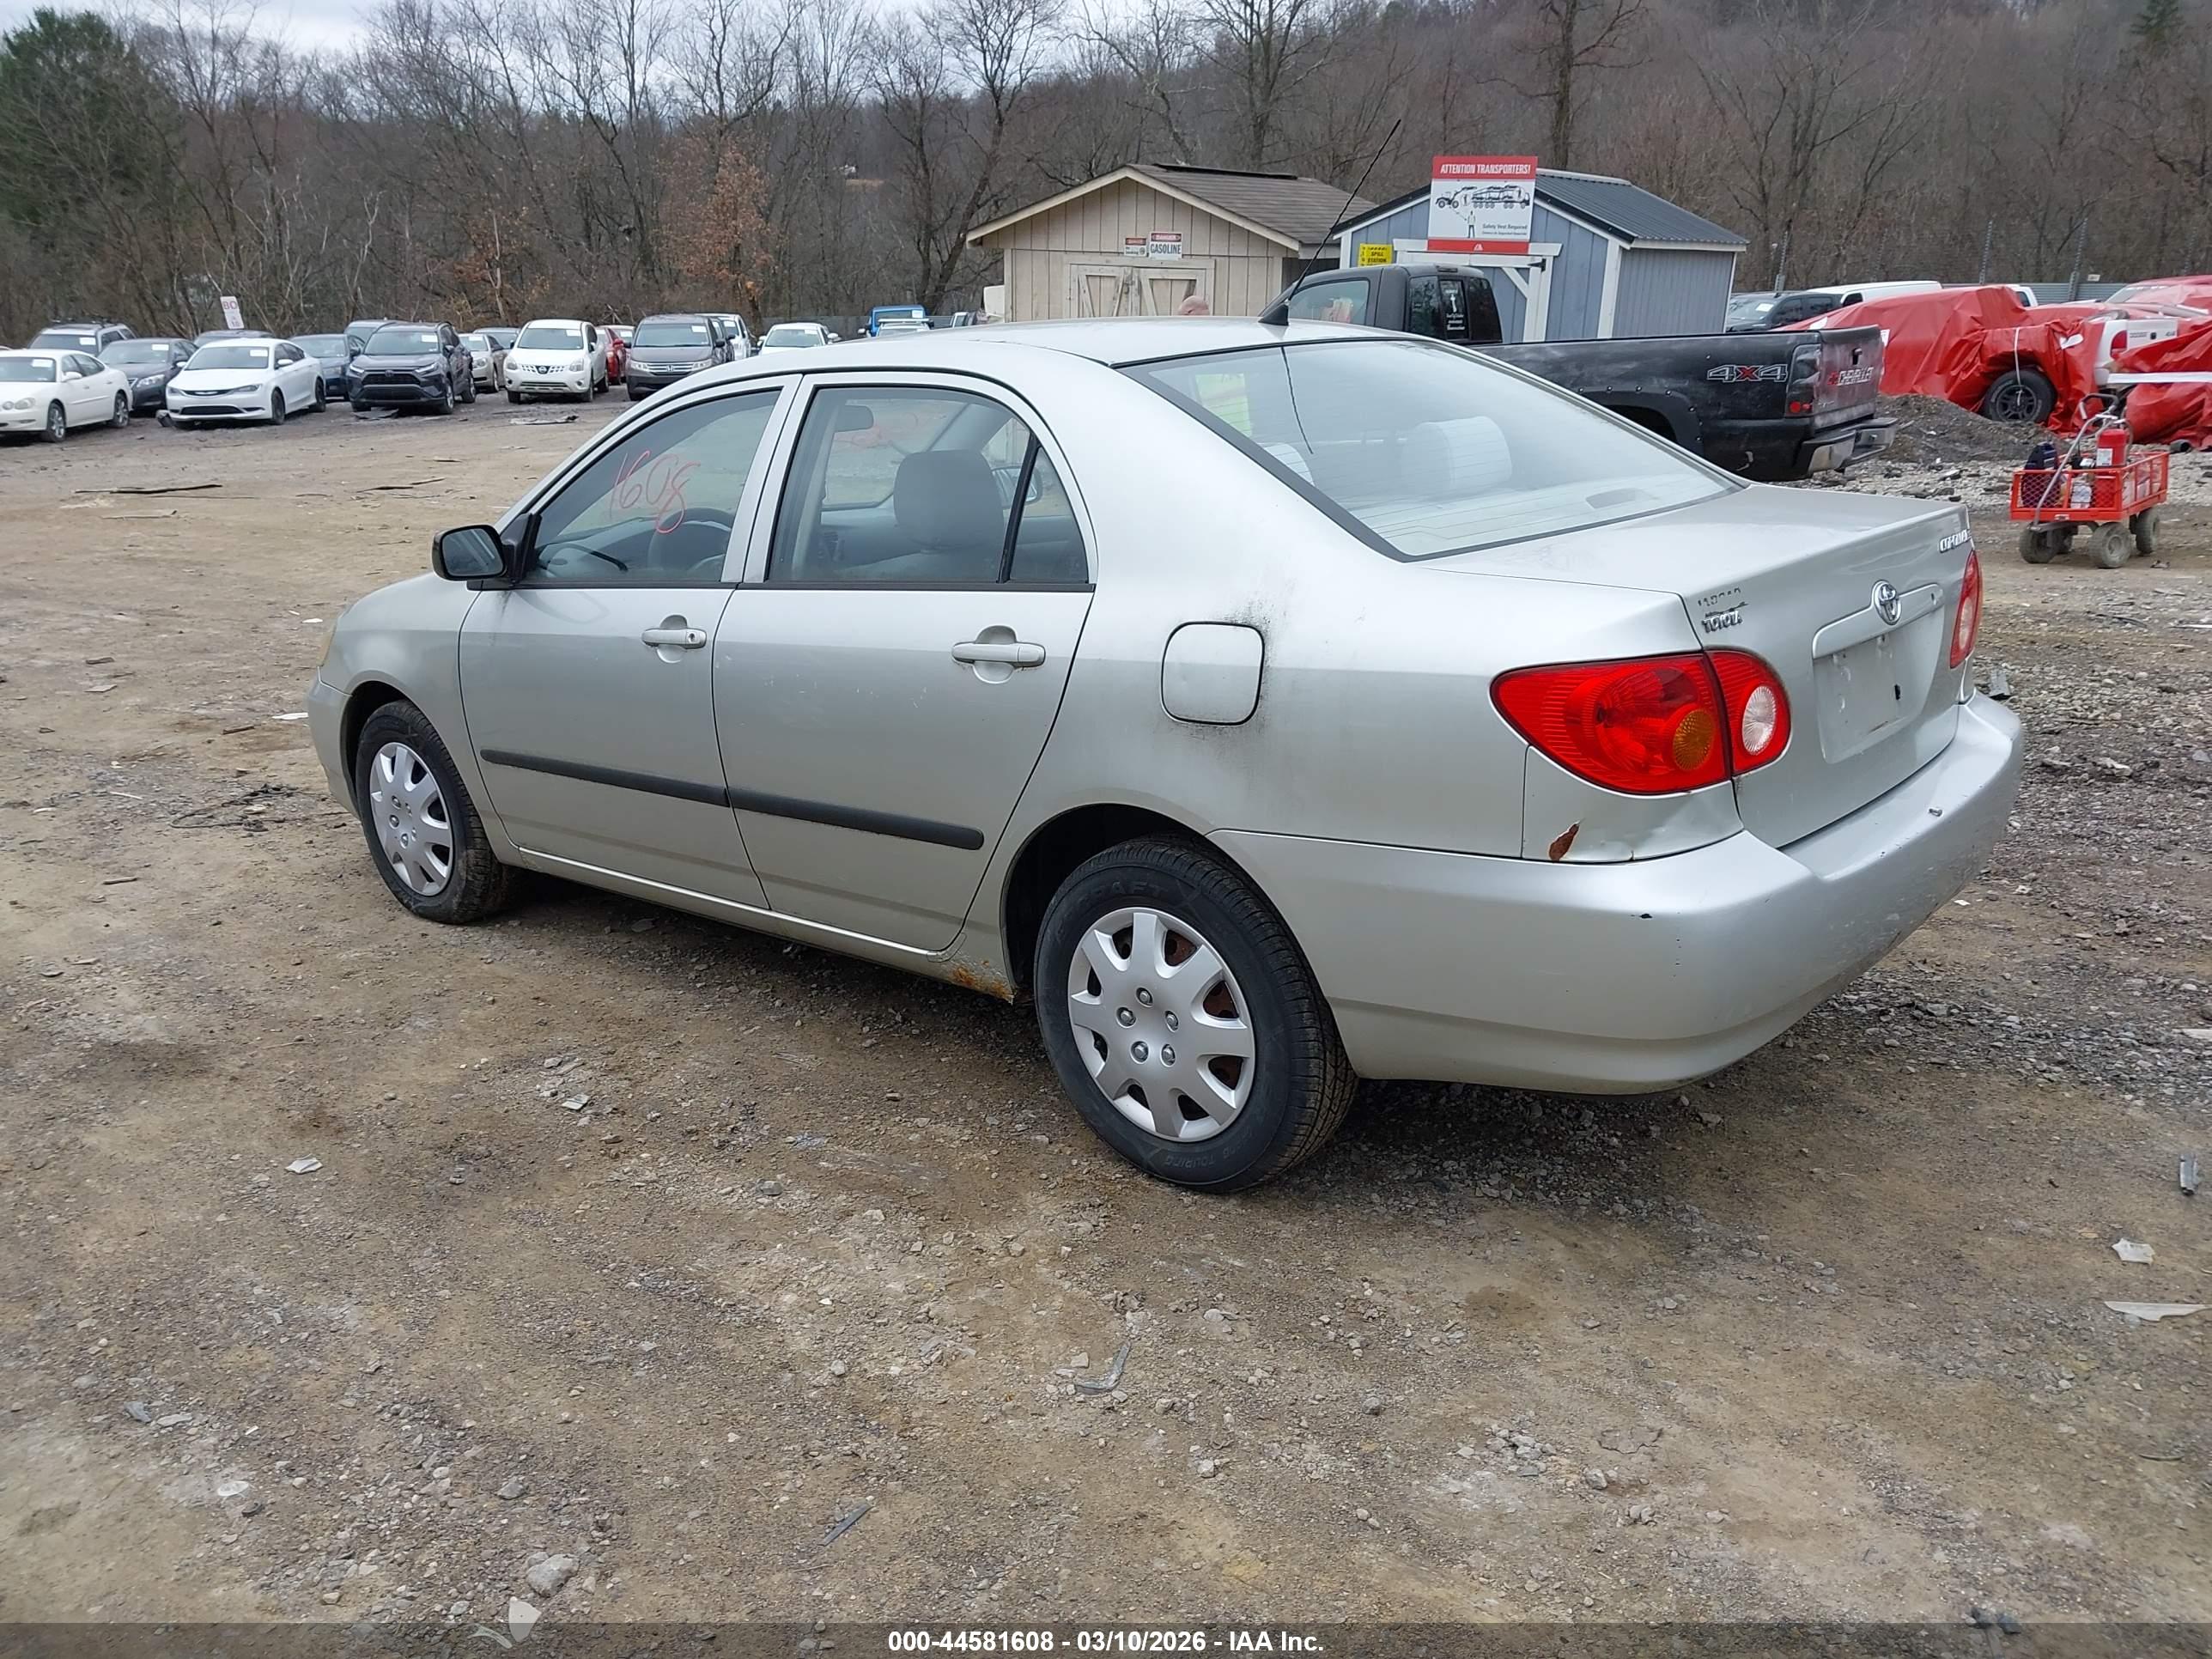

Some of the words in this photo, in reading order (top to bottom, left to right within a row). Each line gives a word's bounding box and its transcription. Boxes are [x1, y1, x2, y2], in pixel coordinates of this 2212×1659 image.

[1440, 164, 1475, 174] ATTENTION
[1477, 164, 1530, 174] TRANSPORTERS!
[1151, 244, 1181, 254] GASOLINE
[610, 450, 702, 534] 1608
